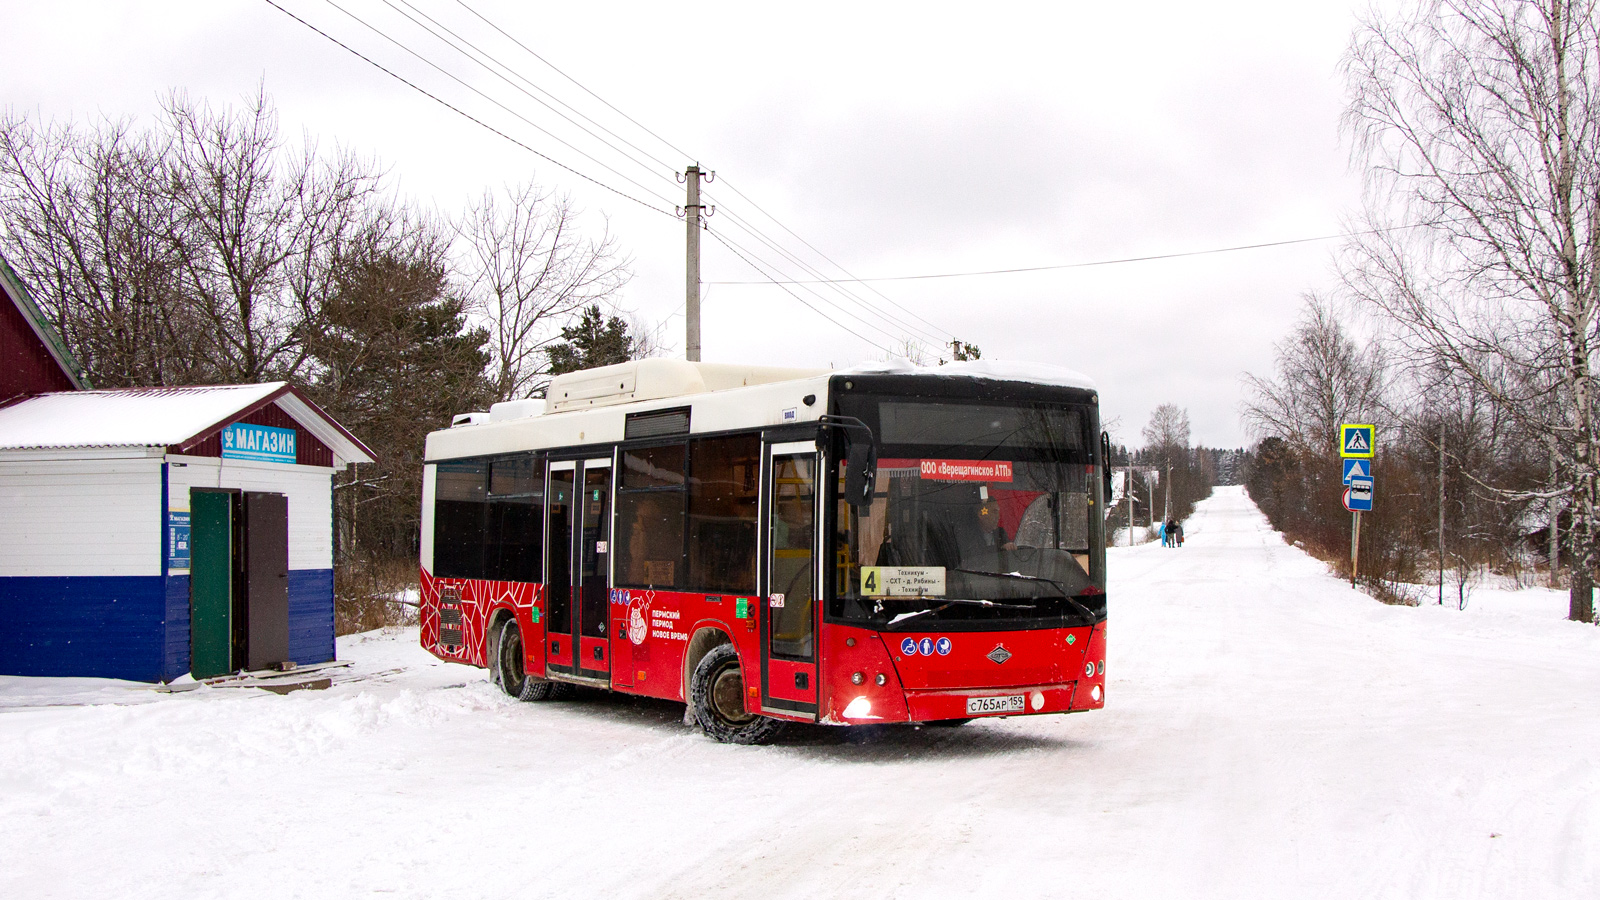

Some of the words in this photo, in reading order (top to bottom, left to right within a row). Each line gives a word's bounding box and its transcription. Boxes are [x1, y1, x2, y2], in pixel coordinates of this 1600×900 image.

[236, 427, 294, 454] МАГАЗИН
[921, 461, 937, 474] ООО
[938, 462, 994, 478] «Верещагинское
[995, 464, 1012, 477] АТП»
[864, 570, 877, 593] 4
[652, 609, 680, 620] ПЕРМСКИЙ
[652, 619, 674, 630] ПЕРИОД
[652, 630, 670, 639] НОВОЕ
[670, 631, 688, 641] ВРЕМЯ
[1008, 696, 1023, 706] 159
